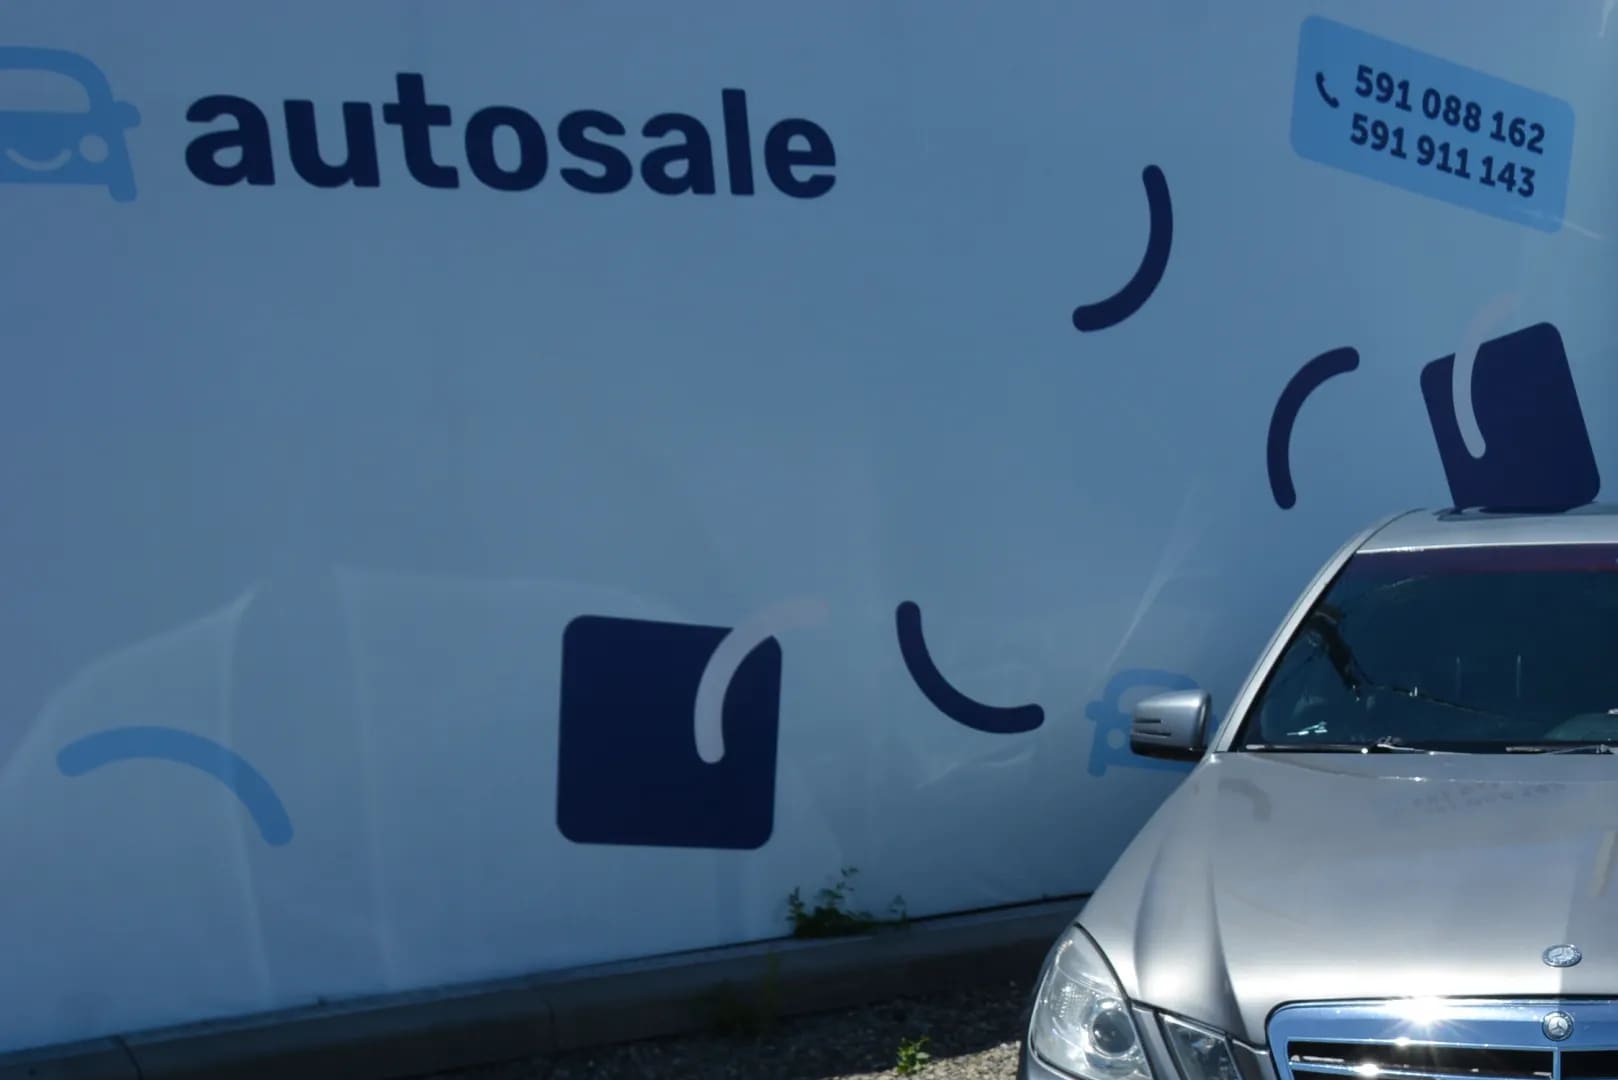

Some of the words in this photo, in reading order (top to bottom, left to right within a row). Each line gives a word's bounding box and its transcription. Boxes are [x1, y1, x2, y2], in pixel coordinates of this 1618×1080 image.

[184, 71, 837, 200] autosale
[1354, 64, 1413, 112] 591
[1422, 87, 1482, 133] 088
[1489, 110, 1545, 155] 162
[1349, 113, 1408, 159] 591
[1417, 134, 1471, 179] 911
[1479, 155, 1536, 198] 143
